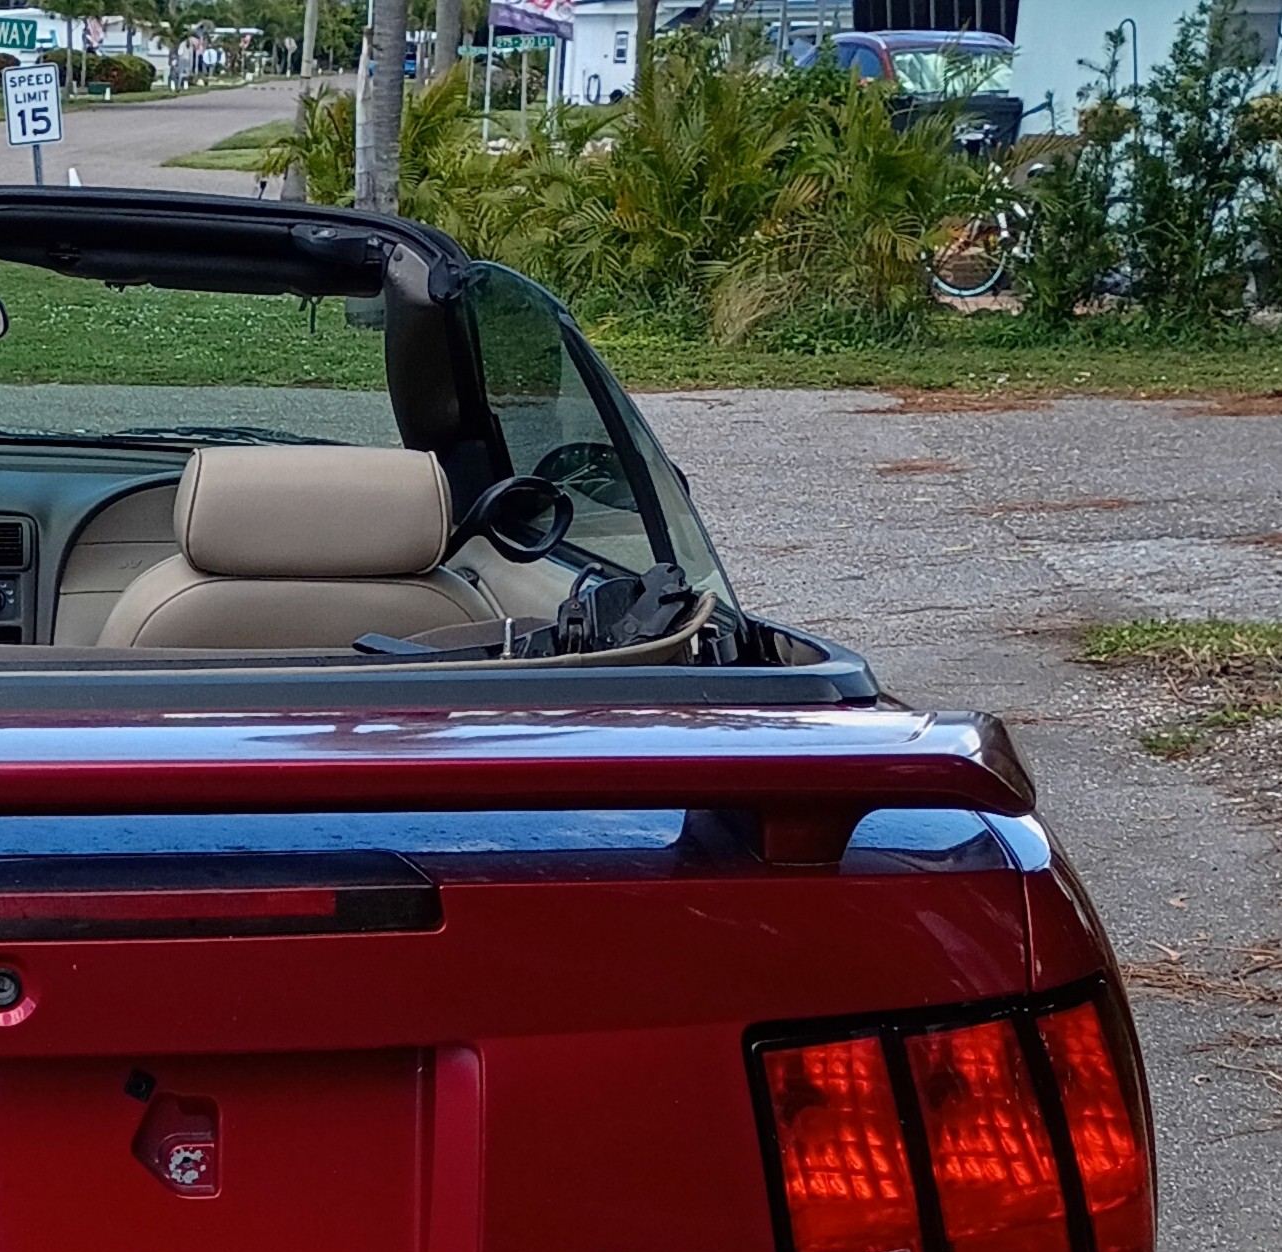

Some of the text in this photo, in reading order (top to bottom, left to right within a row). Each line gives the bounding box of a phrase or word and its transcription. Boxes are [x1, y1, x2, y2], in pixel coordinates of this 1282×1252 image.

[9, 73, 53, 88] SPEED
[14, 90, 49, 104] LIMIT
[17, 107, 51, 136] 15
